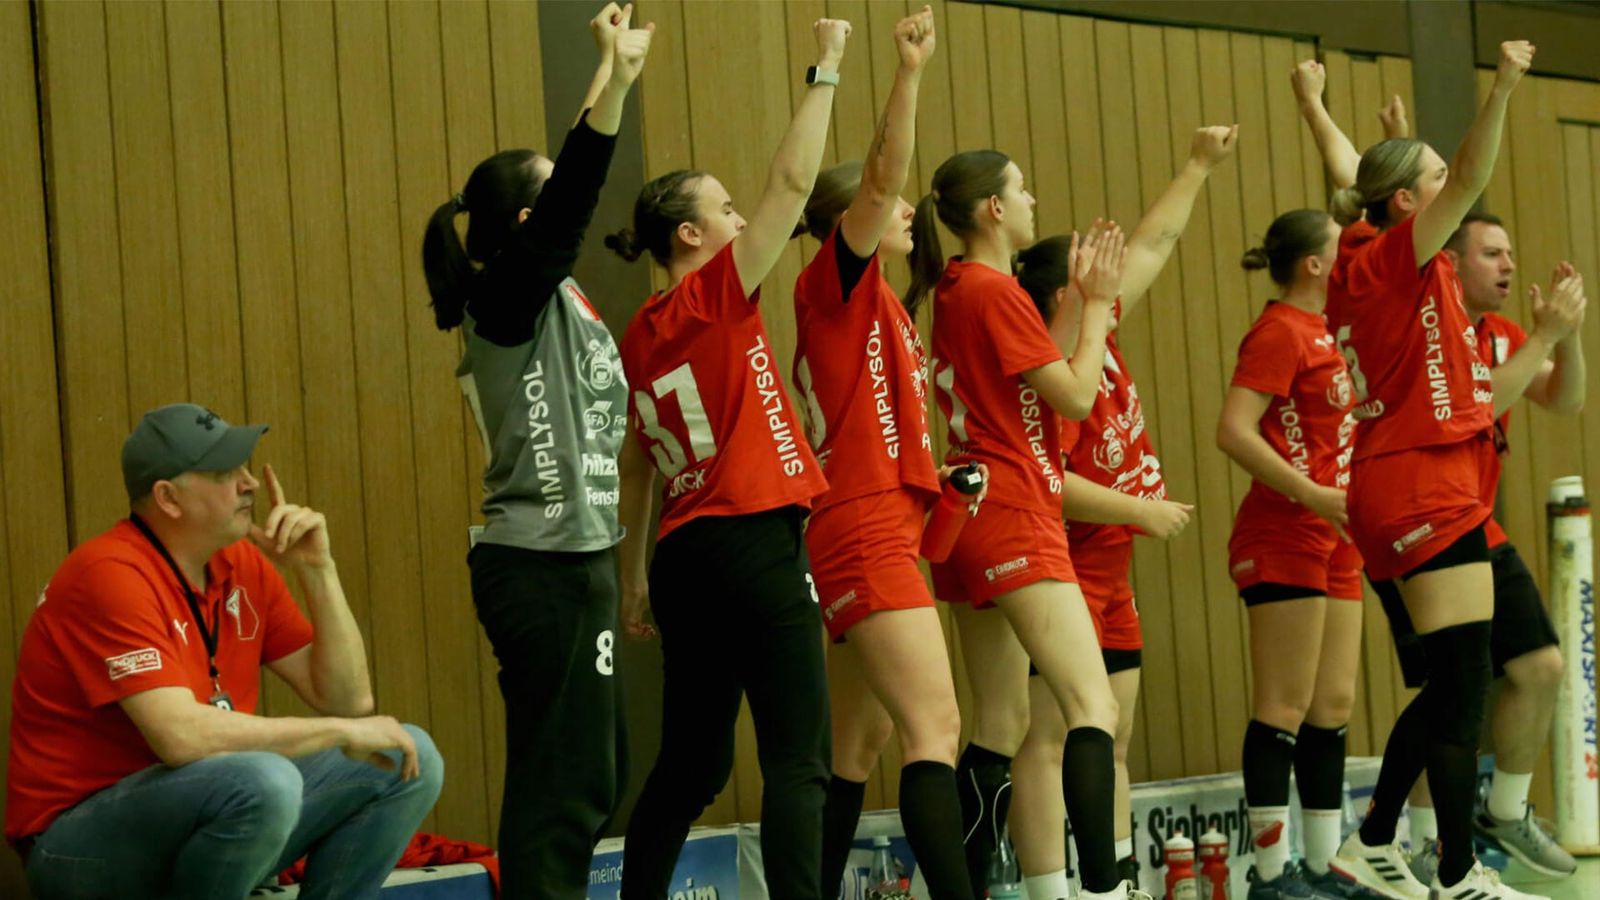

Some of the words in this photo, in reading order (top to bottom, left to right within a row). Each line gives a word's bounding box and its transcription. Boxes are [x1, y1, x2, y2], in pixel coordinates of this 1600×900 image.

[746, 335, 804, 477] SIMPLYSOL
[866, 320, 899, 459] SIMPLYSOL
[1420, 296, 1452, 421] SIMPLYSOL
[523, 360, 564, 519] SIMPLYSOL
[1019, 383, 1062, 495] SIMPLYSO
